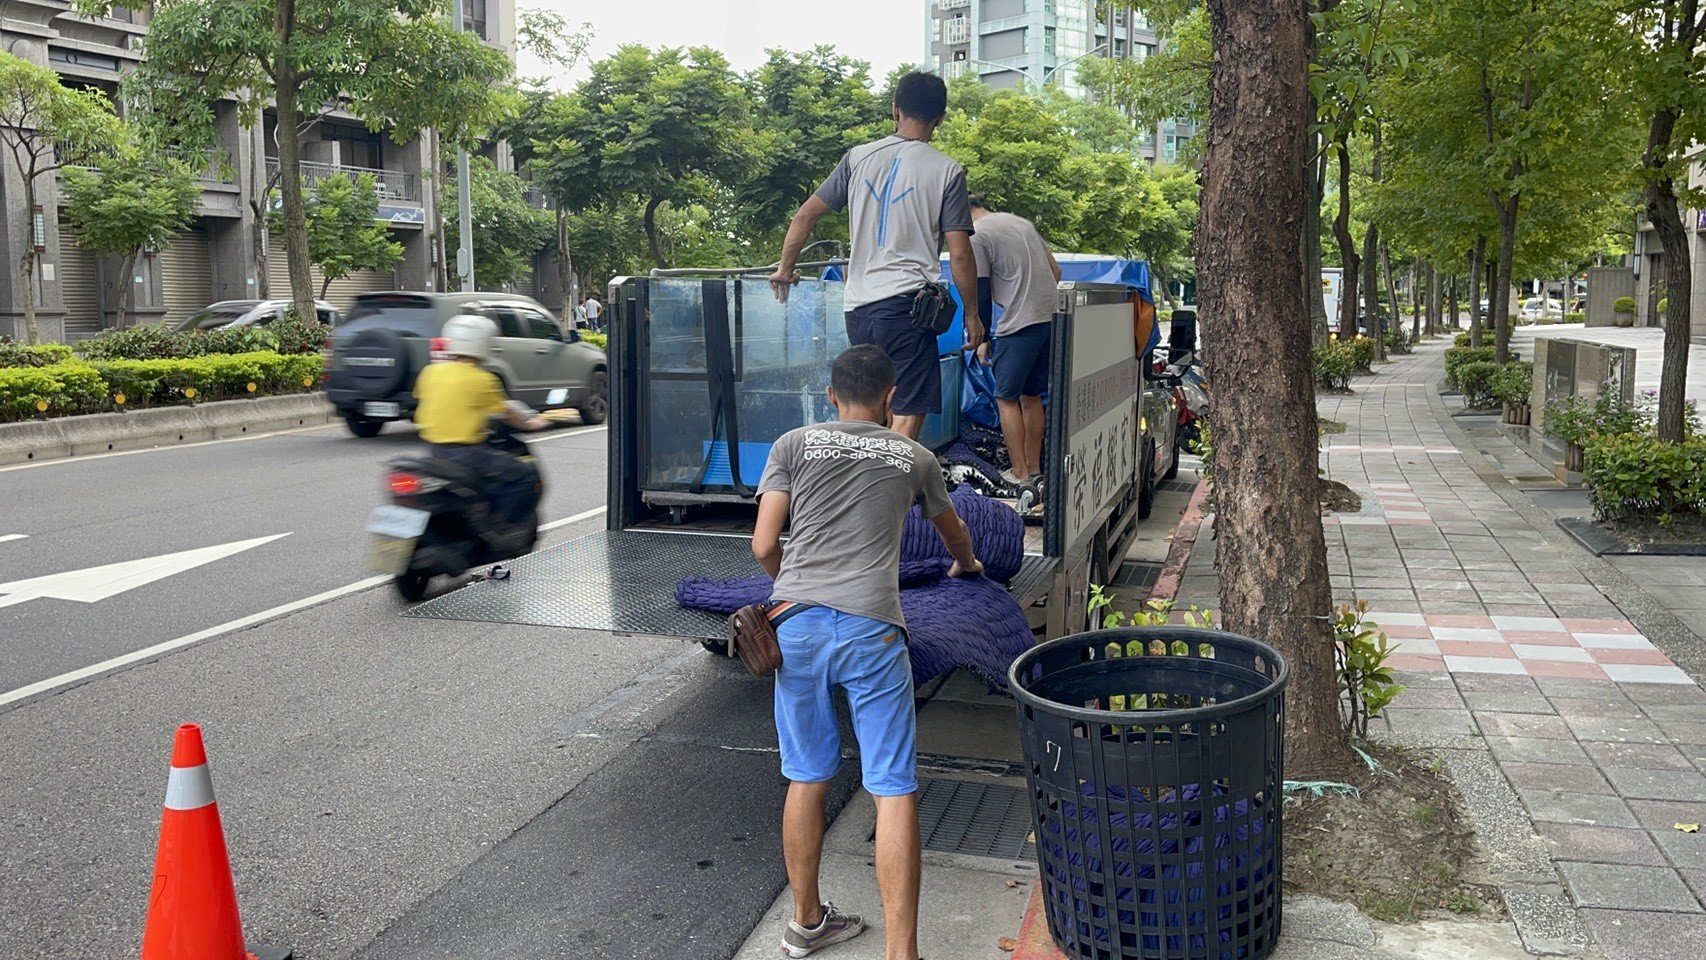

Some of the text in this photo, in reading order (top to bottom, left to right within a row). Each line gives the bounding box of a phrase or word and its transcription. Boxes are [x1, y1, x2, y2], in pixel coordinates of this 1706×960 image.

[804, 429, 914, 458] 榮福搬家
[1073, 412, 1129, 535] 榮福搬家
[1046, 740, 1062, 772] 7
